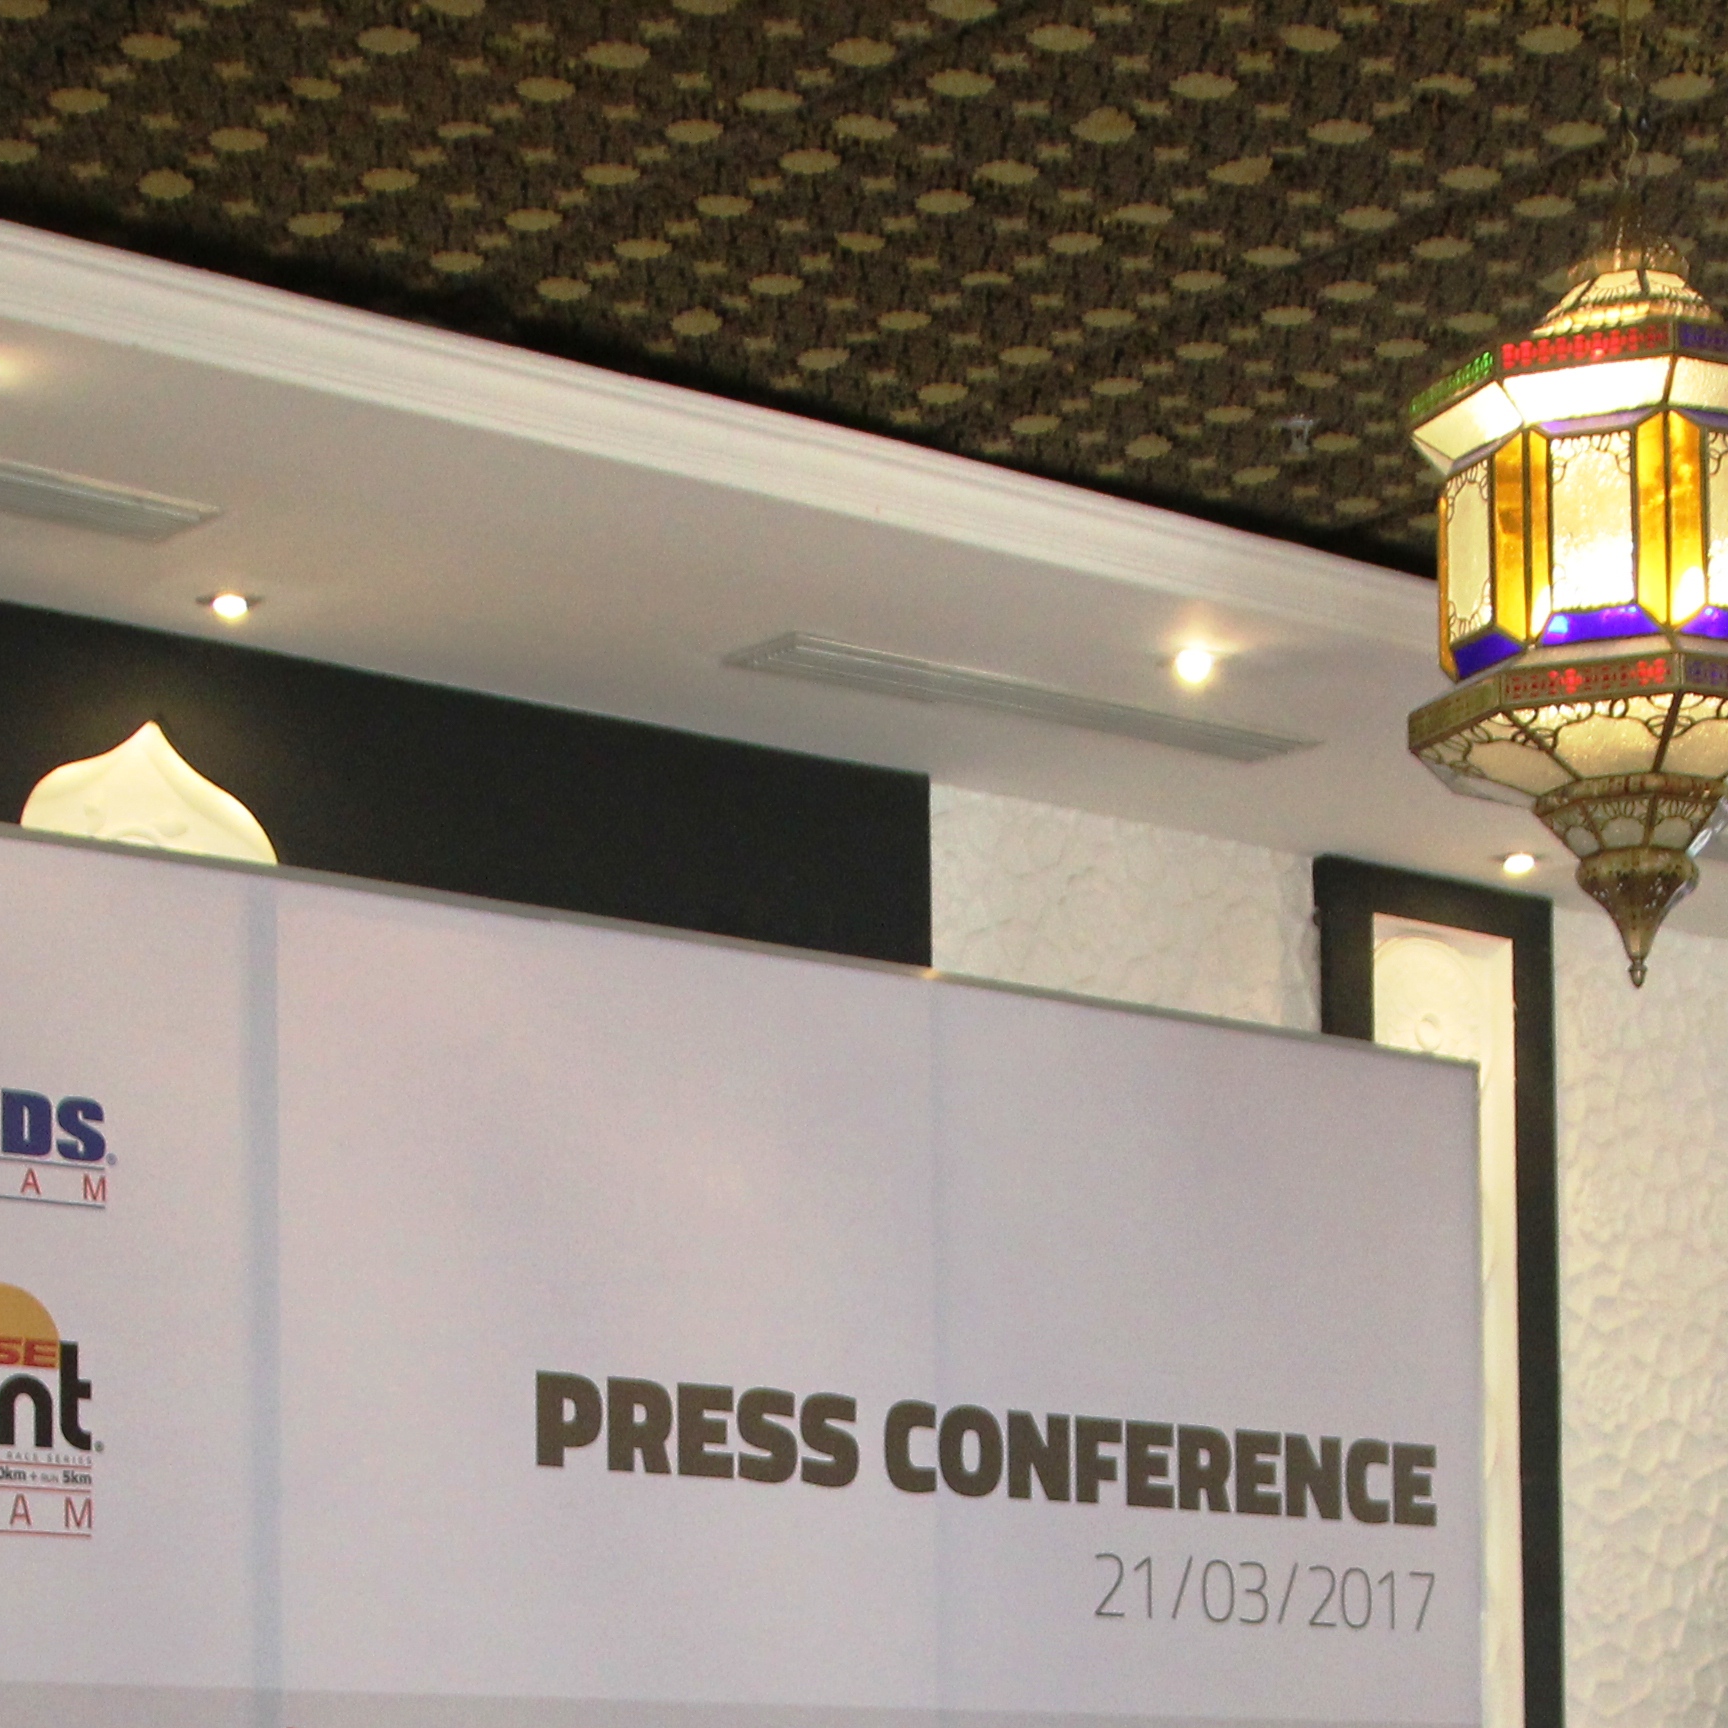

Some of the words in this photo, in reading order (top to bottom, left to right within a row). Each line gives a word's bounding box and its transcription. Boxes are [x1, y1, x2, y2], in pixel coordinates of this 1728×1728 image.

[62, 1470, 92, 1485] 5km
[535, 1370, 860, 1489] PRESS
[884, 1398, 1438, 1527] CONFERENCE
[1094, 1553, 1436, 1633] 21/03/2017
